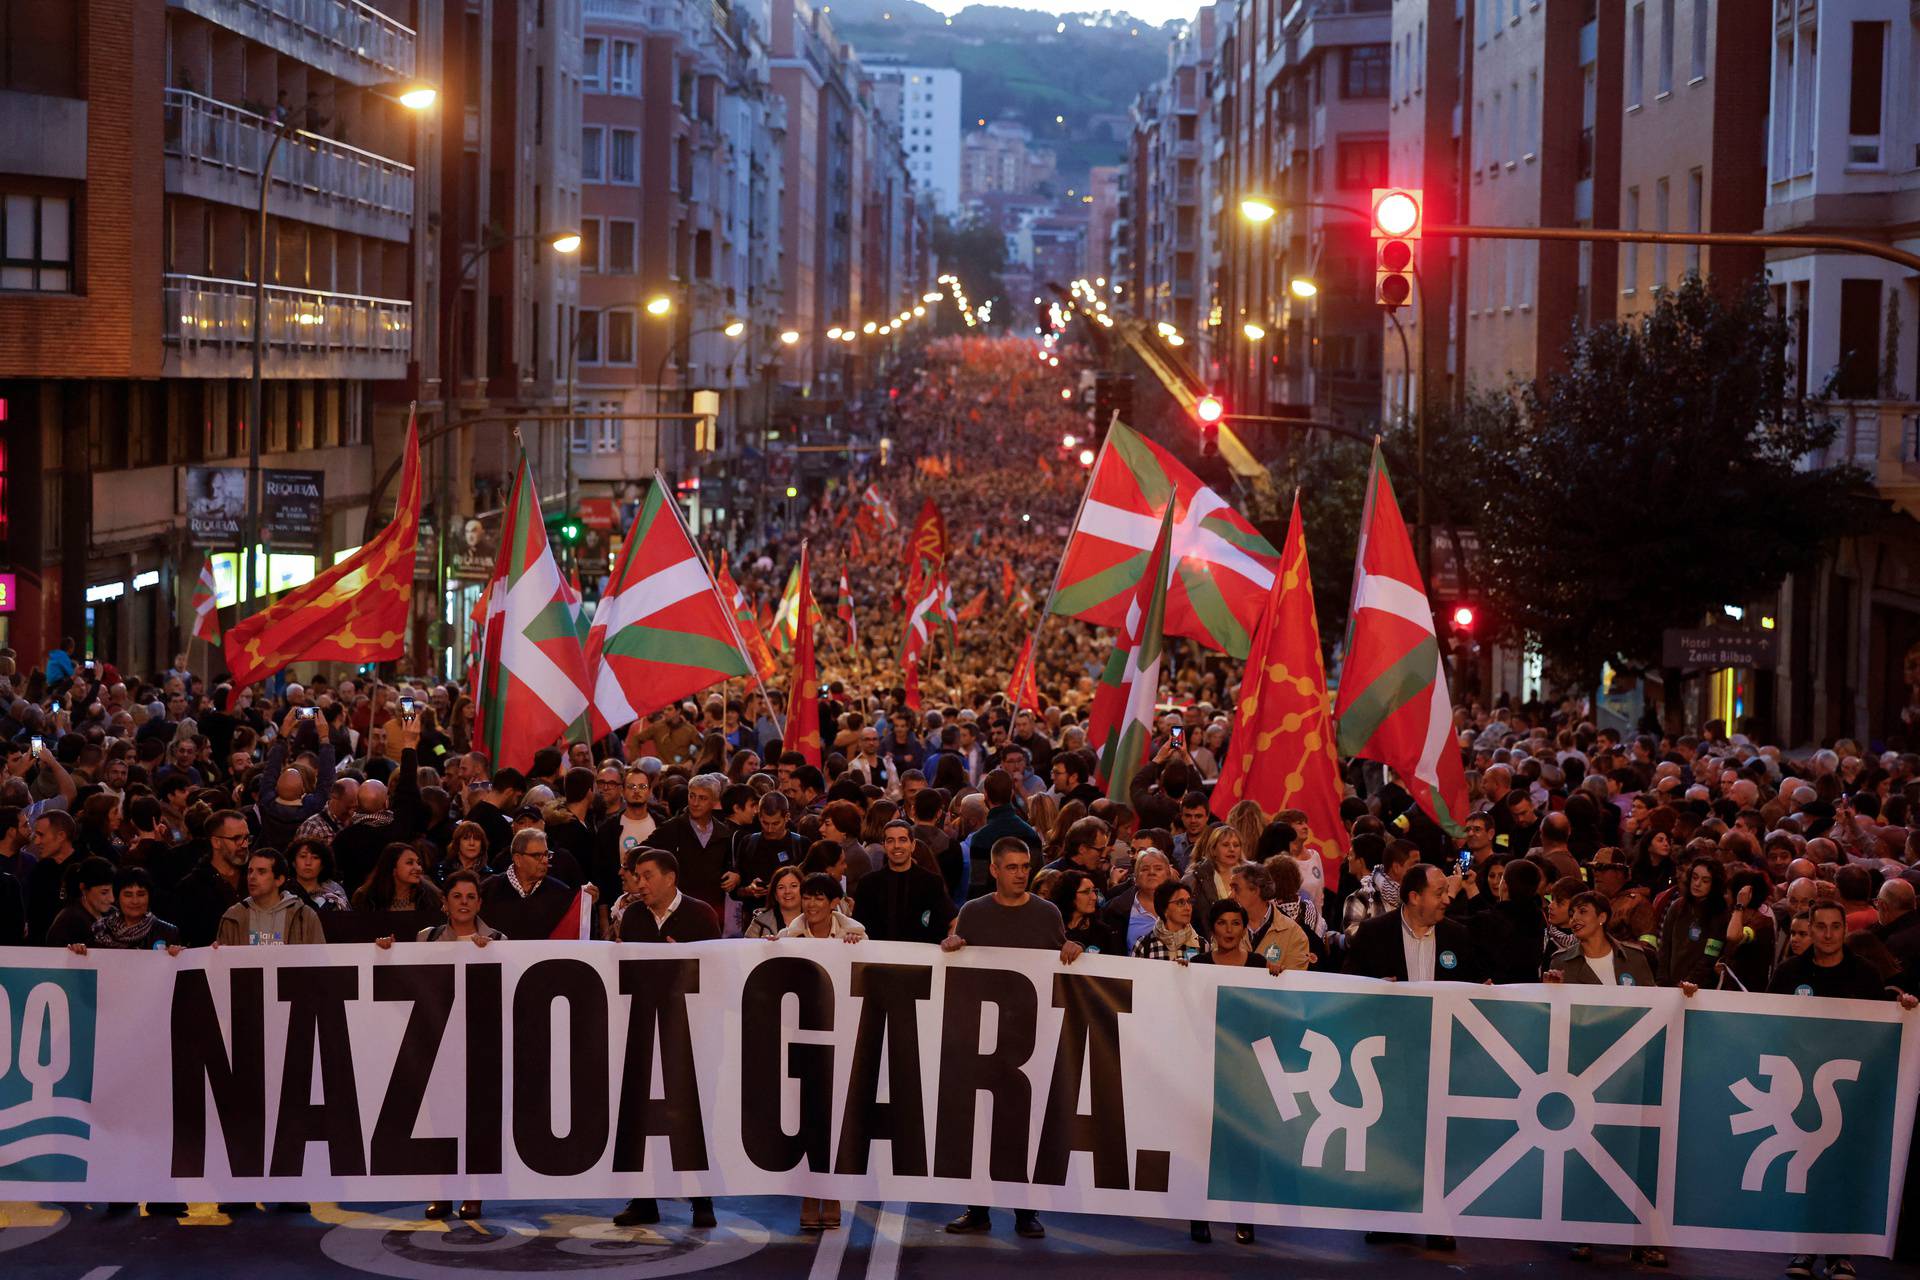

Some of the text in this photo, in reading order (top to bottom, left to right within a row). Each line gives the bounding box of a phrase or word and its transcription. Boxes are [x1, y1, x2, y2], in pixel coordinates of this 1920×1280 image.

[1681, 637, 1711, 649] Hotel
[1689, 649, 1752, 663] Zenit Bilbao
[171, 956, 1170, 1193] NAZIOA GARA.
